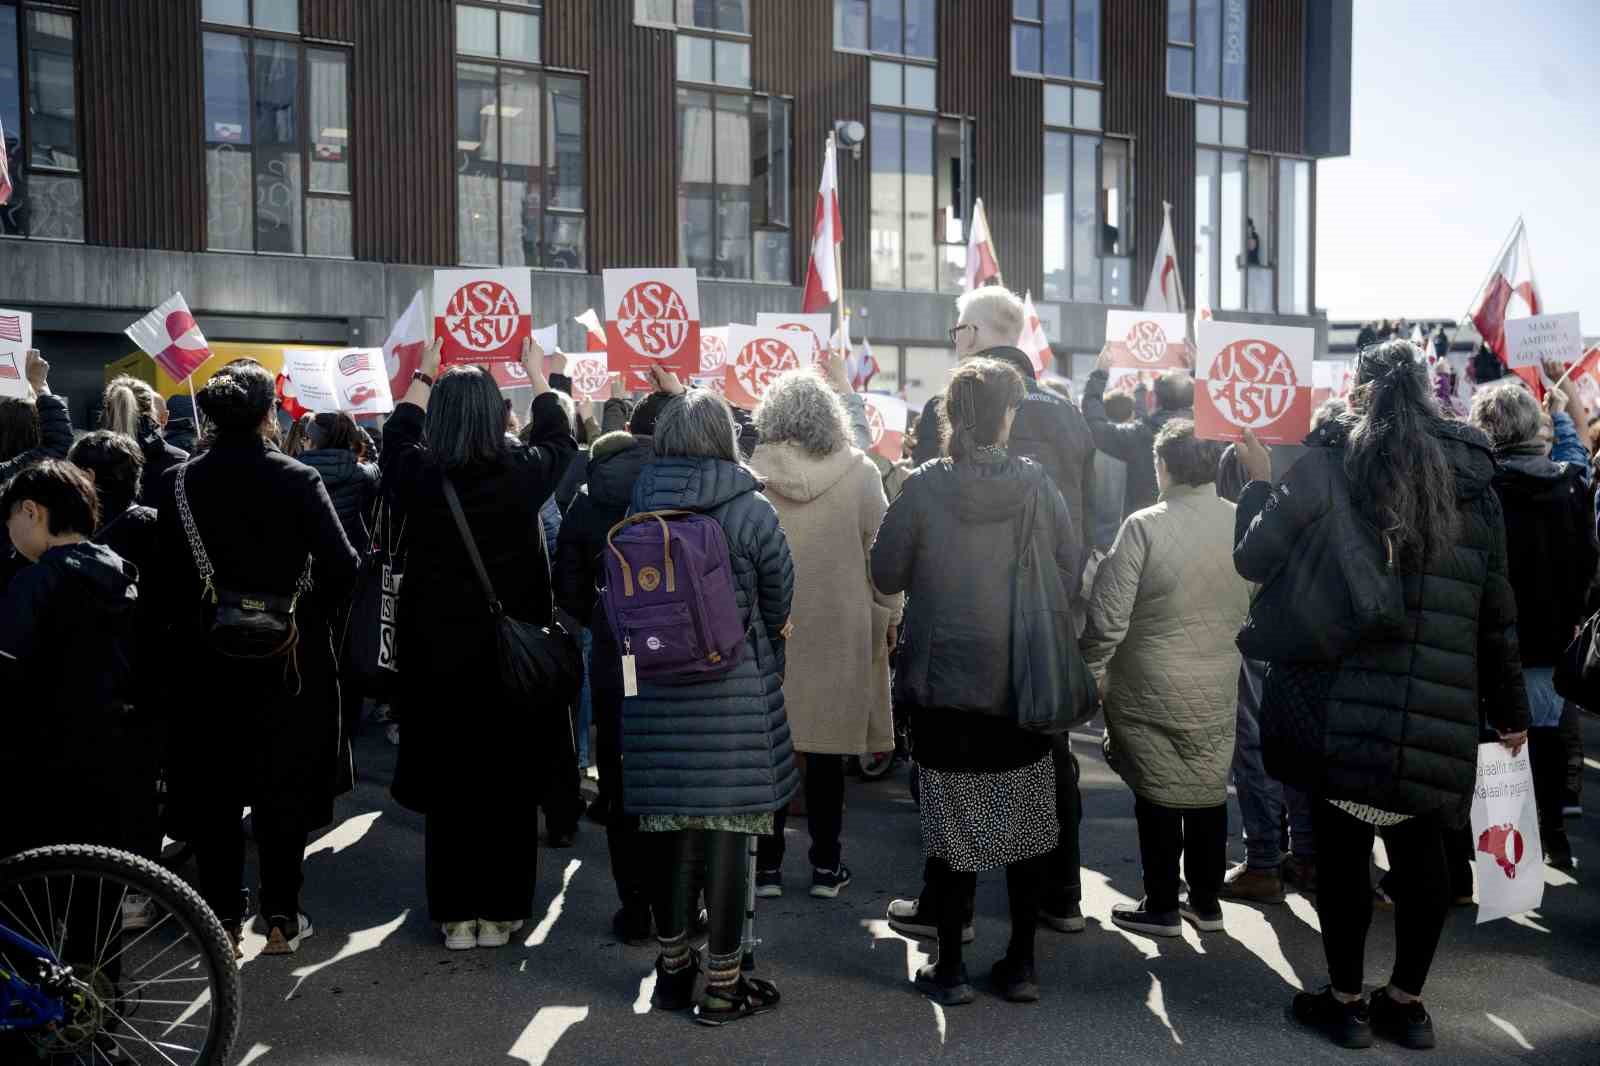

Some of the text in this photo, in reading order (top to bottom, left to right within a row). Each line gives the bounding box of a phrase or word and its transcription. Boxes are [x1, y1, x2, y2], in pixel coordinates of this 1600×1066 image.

[452, 283, 515, 316] USA
[623, 283, 685, 320] USA
[451, 315, 513, 348] ASU
[623, 319, 684, 354] ASU
[1129, 320, 1166, 343] USA
[743, 340, 798, 369] USA
[1216, 342, 1292, 385] USA
[1211, 379, 1289, 424] ASU
